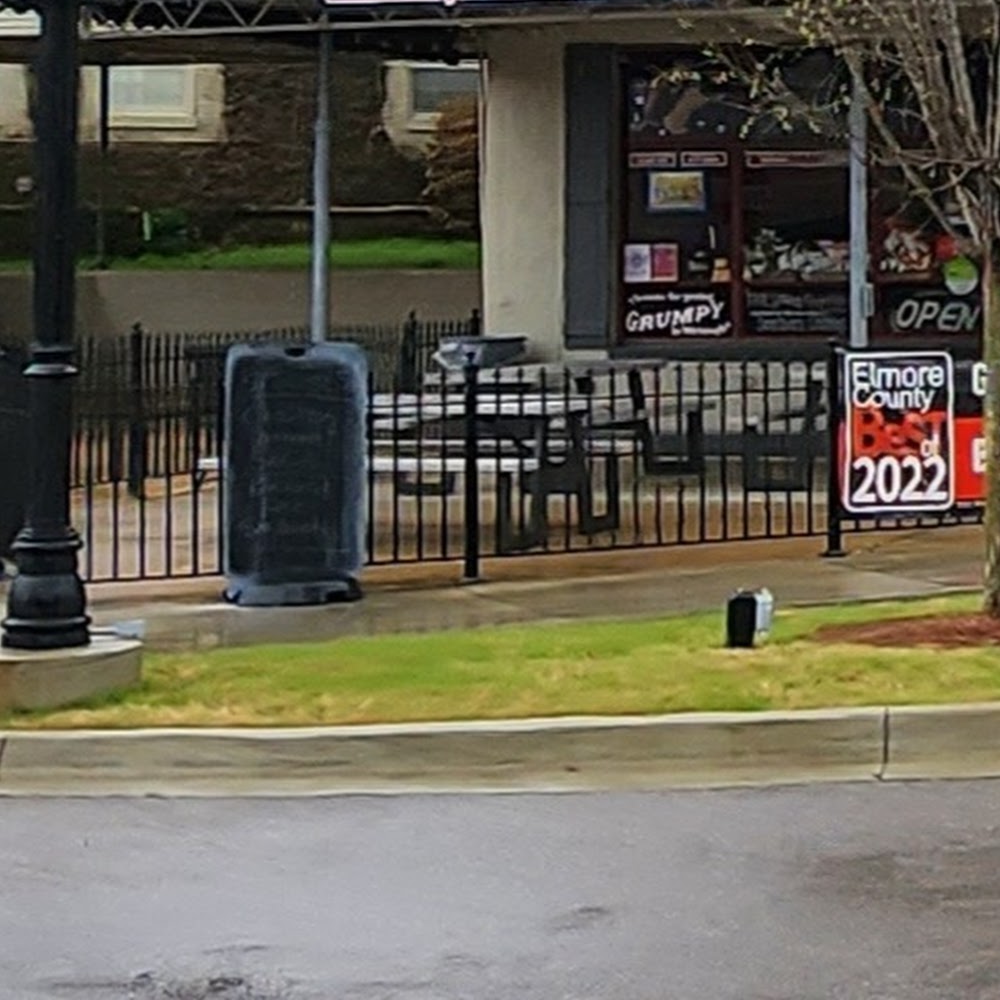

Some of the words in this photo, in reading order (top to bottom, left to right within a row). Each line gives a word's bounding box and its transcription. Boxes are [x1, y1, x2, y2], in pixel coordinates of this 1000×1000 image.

[625, 300, 726, 333] GRUMPY
[895, 299, 981, 332] OPEN
[852, 361, 945, 389] Elmore
[853, 384, 935, 414] County
[852, 455, 947, 502] 2022
